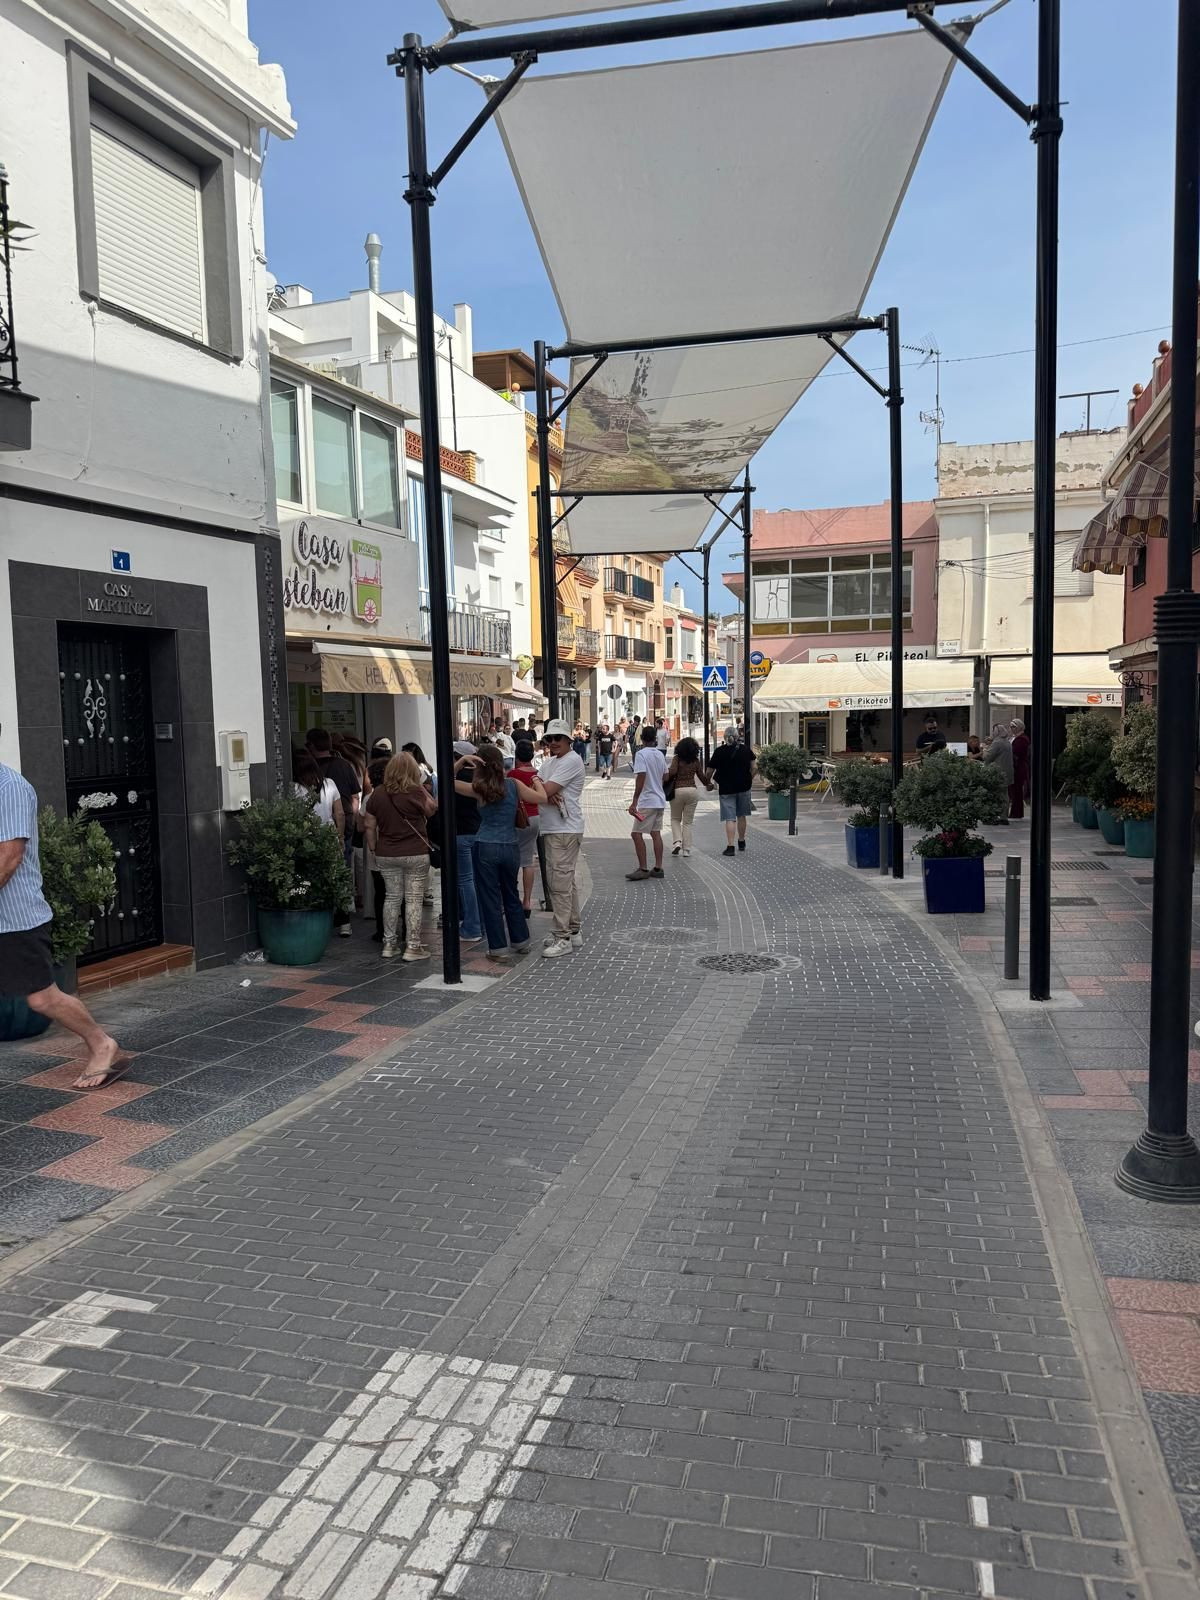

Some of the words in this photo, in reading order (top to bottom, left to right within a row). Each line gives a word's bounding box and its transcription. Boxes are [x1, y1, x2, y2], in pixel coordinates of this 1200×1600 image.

[298, 520, 344, 565] Casa
[118, 558, 124, 569] 1
[104, 582, 134, 598] CASA
[283, 565, 348, 612] steban
[855, 652, 870, 663] EL
[876, 649, 928, 662] Piteo!
[365, 666, 420, 687] HELADOS
[427, 669, 486, 689] AESANOS
[844, 698, 853, 706] El
[857, 696, 892, 705] Pikoteo!
[1106, 693, 1115, 702] El
